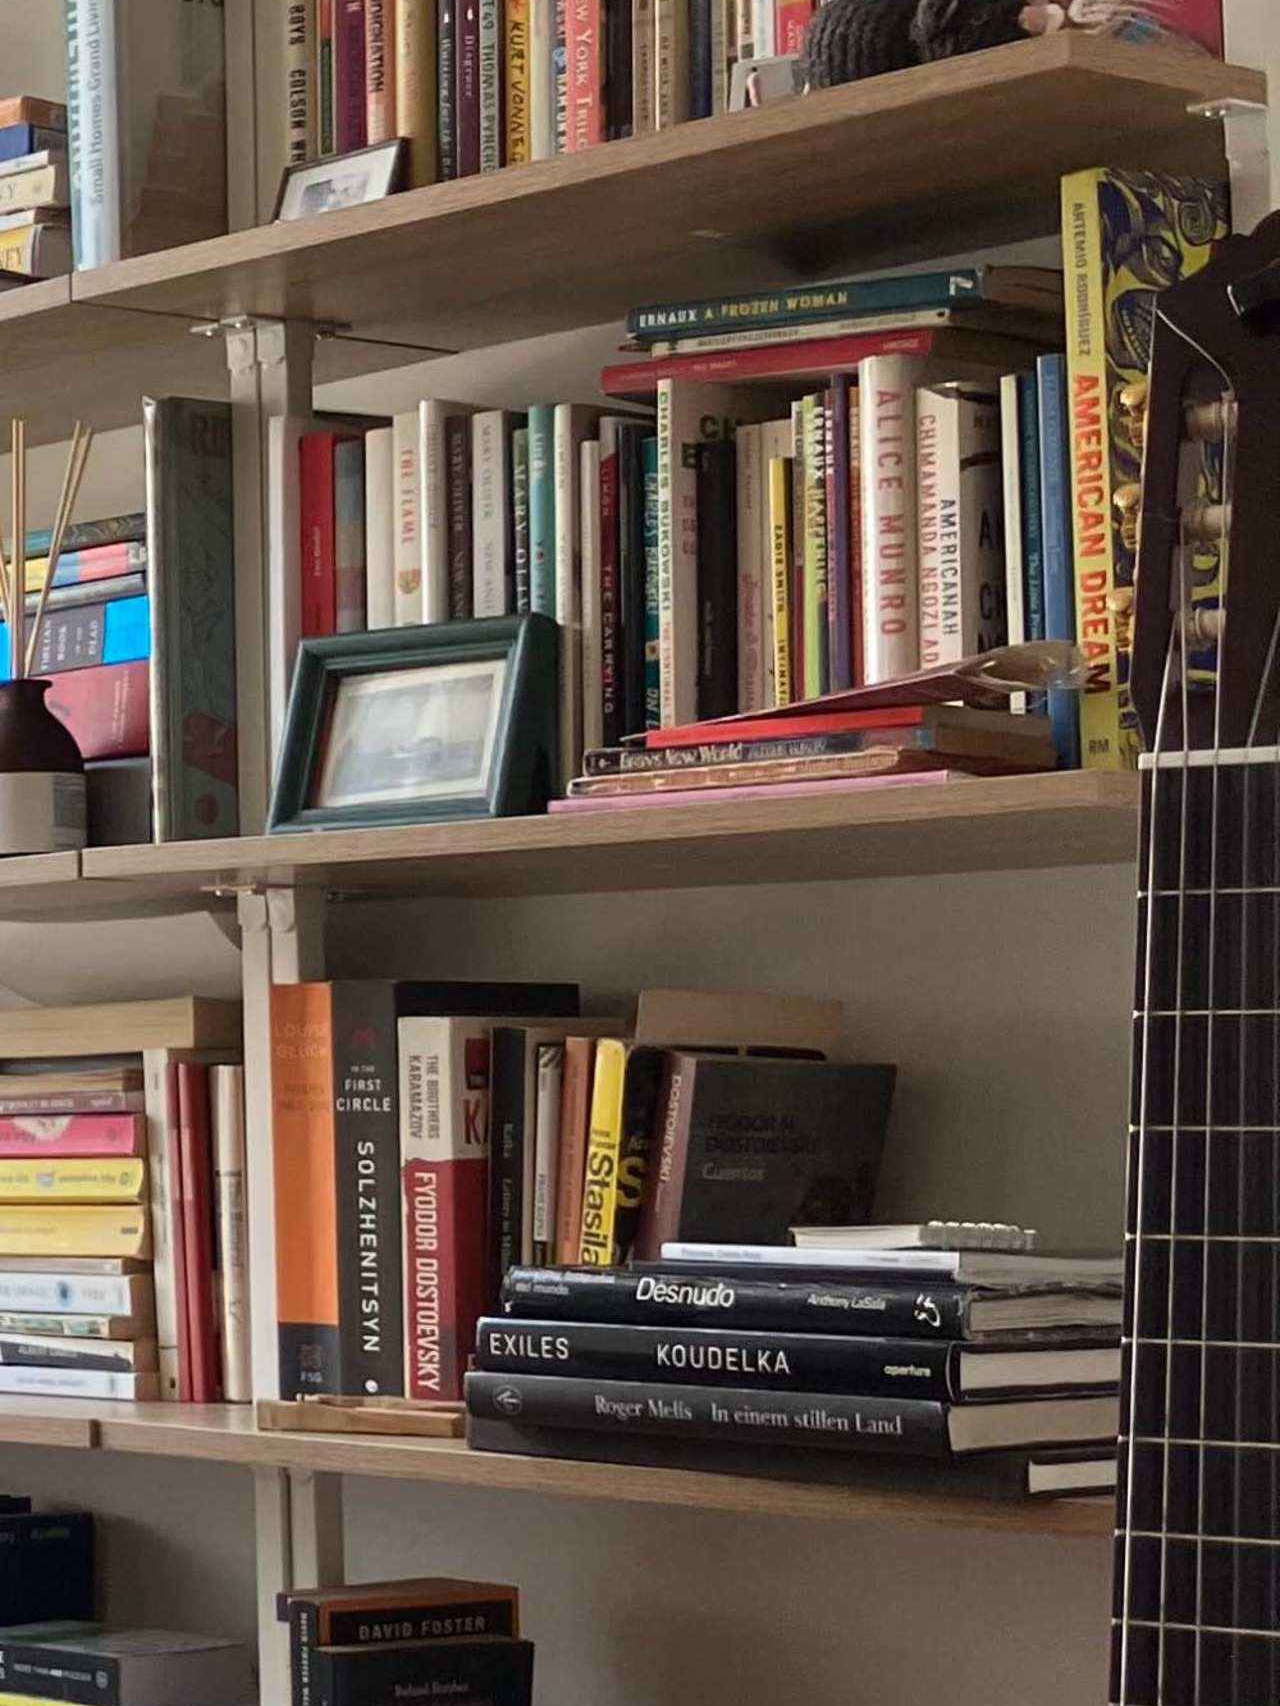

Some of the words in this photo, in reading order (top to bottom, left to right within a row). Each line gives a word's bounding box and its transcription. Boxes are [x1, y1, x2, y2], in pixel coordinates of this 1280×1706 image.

[87, 39, 102, 90] Grand
[480, 42, 496, 109] THOMAS
[510, 20, 526, 72] KURT
[574, 28, 592, 86] YORK
[88, 94, 103, 154] Homes
[290, 69, 306, 133] COLSON
[88, 158, 103, 206] Small
[1072, 201, 1089, 269] ARTEMIO
[639, 309, 698, 329] ERNAUX
[704, 307, 714, 321] A
[720, 300, 780, 320] FROZEN
[788, 291, 849, 312] WOMAN
[399, 445, 415, 477] THE
[658, 391, 669, 490] CHARLES
[875, 389, 903, 492] ALICE
[1073, 374, 1107, 558] AMERICAN
[514, 462, 528, 533] MARY
[645, 472, 658, 537] CHARLES
[919, 414, 937, 557] CHIMAMANDA
[400, 489, 416, 544] FLAME
[774, 524, 783, 566] ZADIE
[603, 563, 613, 605] THE
[660, 499, 671, 612] BUKOWSKI
[878, 514, 907, 637] MUNRO
[940, 498, 959, 637] AMERICANAH
[775, 571, 785, 613] SMITH
[920, 566, 938, 630] NGOZI
[603, 612, 614, 714] CARRYING
[1079, 569, 1112, 697] DREAM
[698, 741, 742, 764] World
[344, 1078, 382, 1093] FIRST
[428, 1054, 440, 1077] THE
[336, 1097, 392, 1112] CIRCLE
[408, 1054, 423, 1140] KARAMAZOV
[427, 1079, 441, 1140] BROTHERS
[414, 1171, 438, 1251] FYODOR
[356, 1141, 382, 1354] SOLZHENITSYN
[635, 1277, 735, 1309] Desnudo
[415, 1257, 441, 1393] DOSTOEVSKY
[488, 1332, 570, 1361] EXILES
[656, 1343, 791, 1375] KOUDELKA
[882, 1363, 932, 1379] aperture
[594, 1395, 641, 1419] Roger
[645, 1398, 693, 1422] Melis
[710, 1402, 730, 1422] In
[733, 1408, 789, 1428] einem
[793, 1410, 850, 1433] stillen
[854, 1412, 903, 1436] Land
[358, 1621, 413, 1641] DAVID
[421, 1615, 487, 1636] FOSTER
